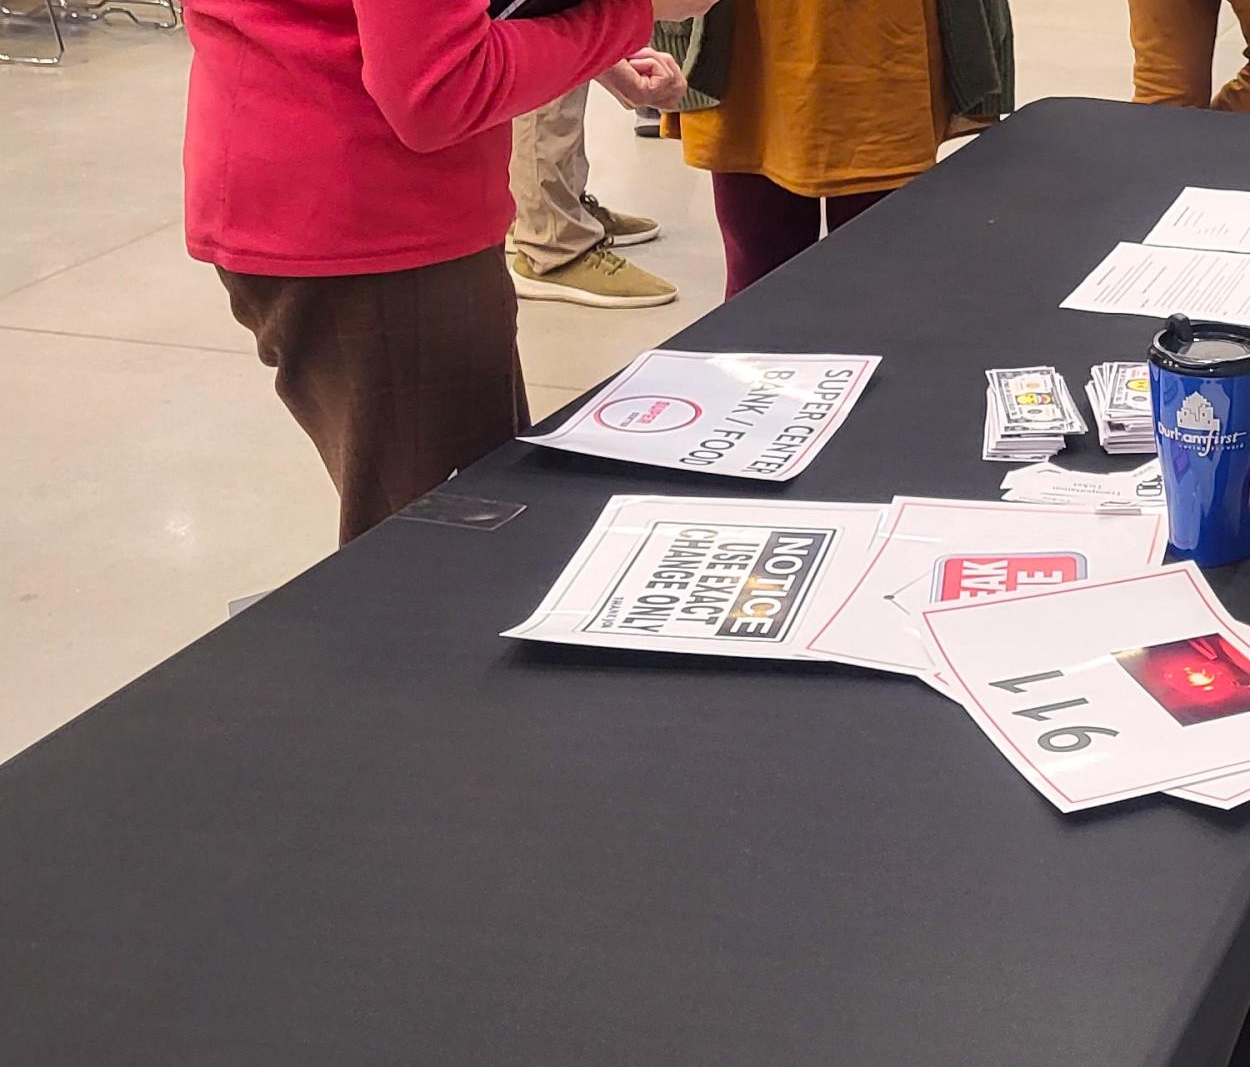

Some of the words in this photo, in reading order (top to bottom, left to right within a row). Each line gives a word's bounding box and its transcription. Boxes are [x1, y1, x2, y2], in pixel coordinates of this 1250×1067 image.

[732, 370, 796, 415] BANK
[793, 369, 853, 421] SUPER
[679, 429, 746, 467] FOOD
[741, 425, 814, 475] CENTER
[645, 528, 719, 590] CHANGE
[706, 542, 760, 571] USE
[676, 575, 742, 625] EXACT
[729, 536, 814, 634] NOTICE
[617, 594, 681, 633] ONLY
[988, 669, 1120, 752] 911
